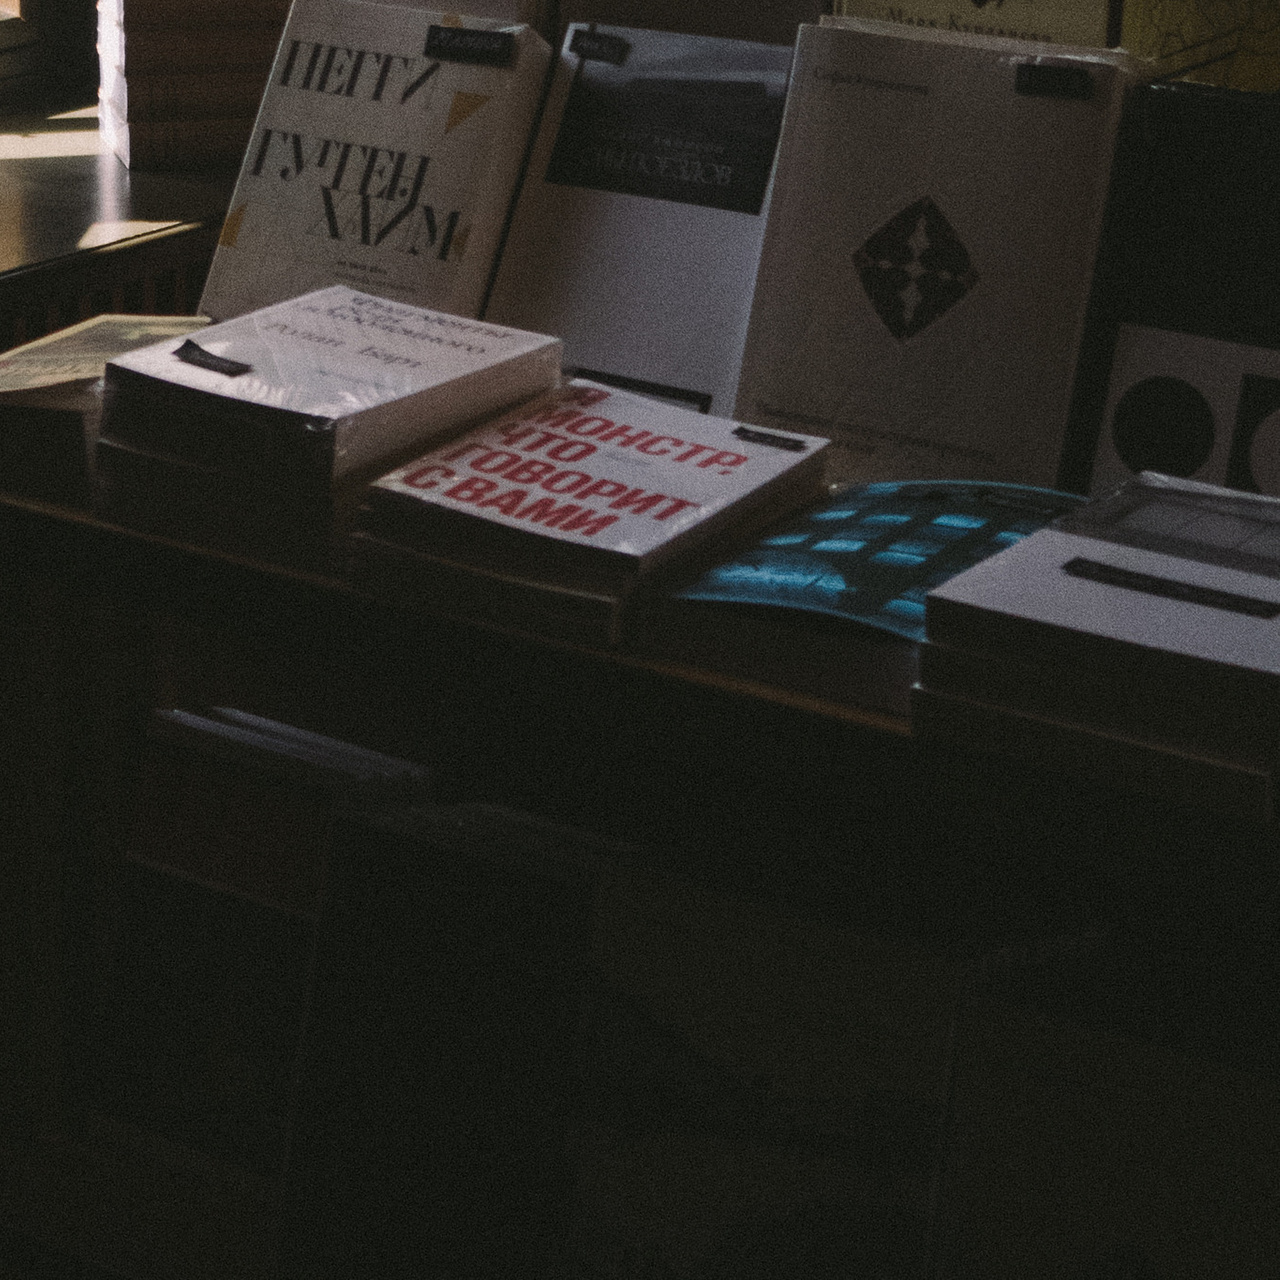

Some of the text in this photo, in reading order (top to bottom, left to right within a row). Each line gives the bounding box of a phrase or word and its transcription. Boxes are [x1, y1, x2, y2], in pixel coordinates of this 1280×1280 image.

[498, 421, 598, 464] ЧТО
[403, 465, 622, 537] С ВАМИ
[442, 442, 701, 521] ГОВОРИТ
